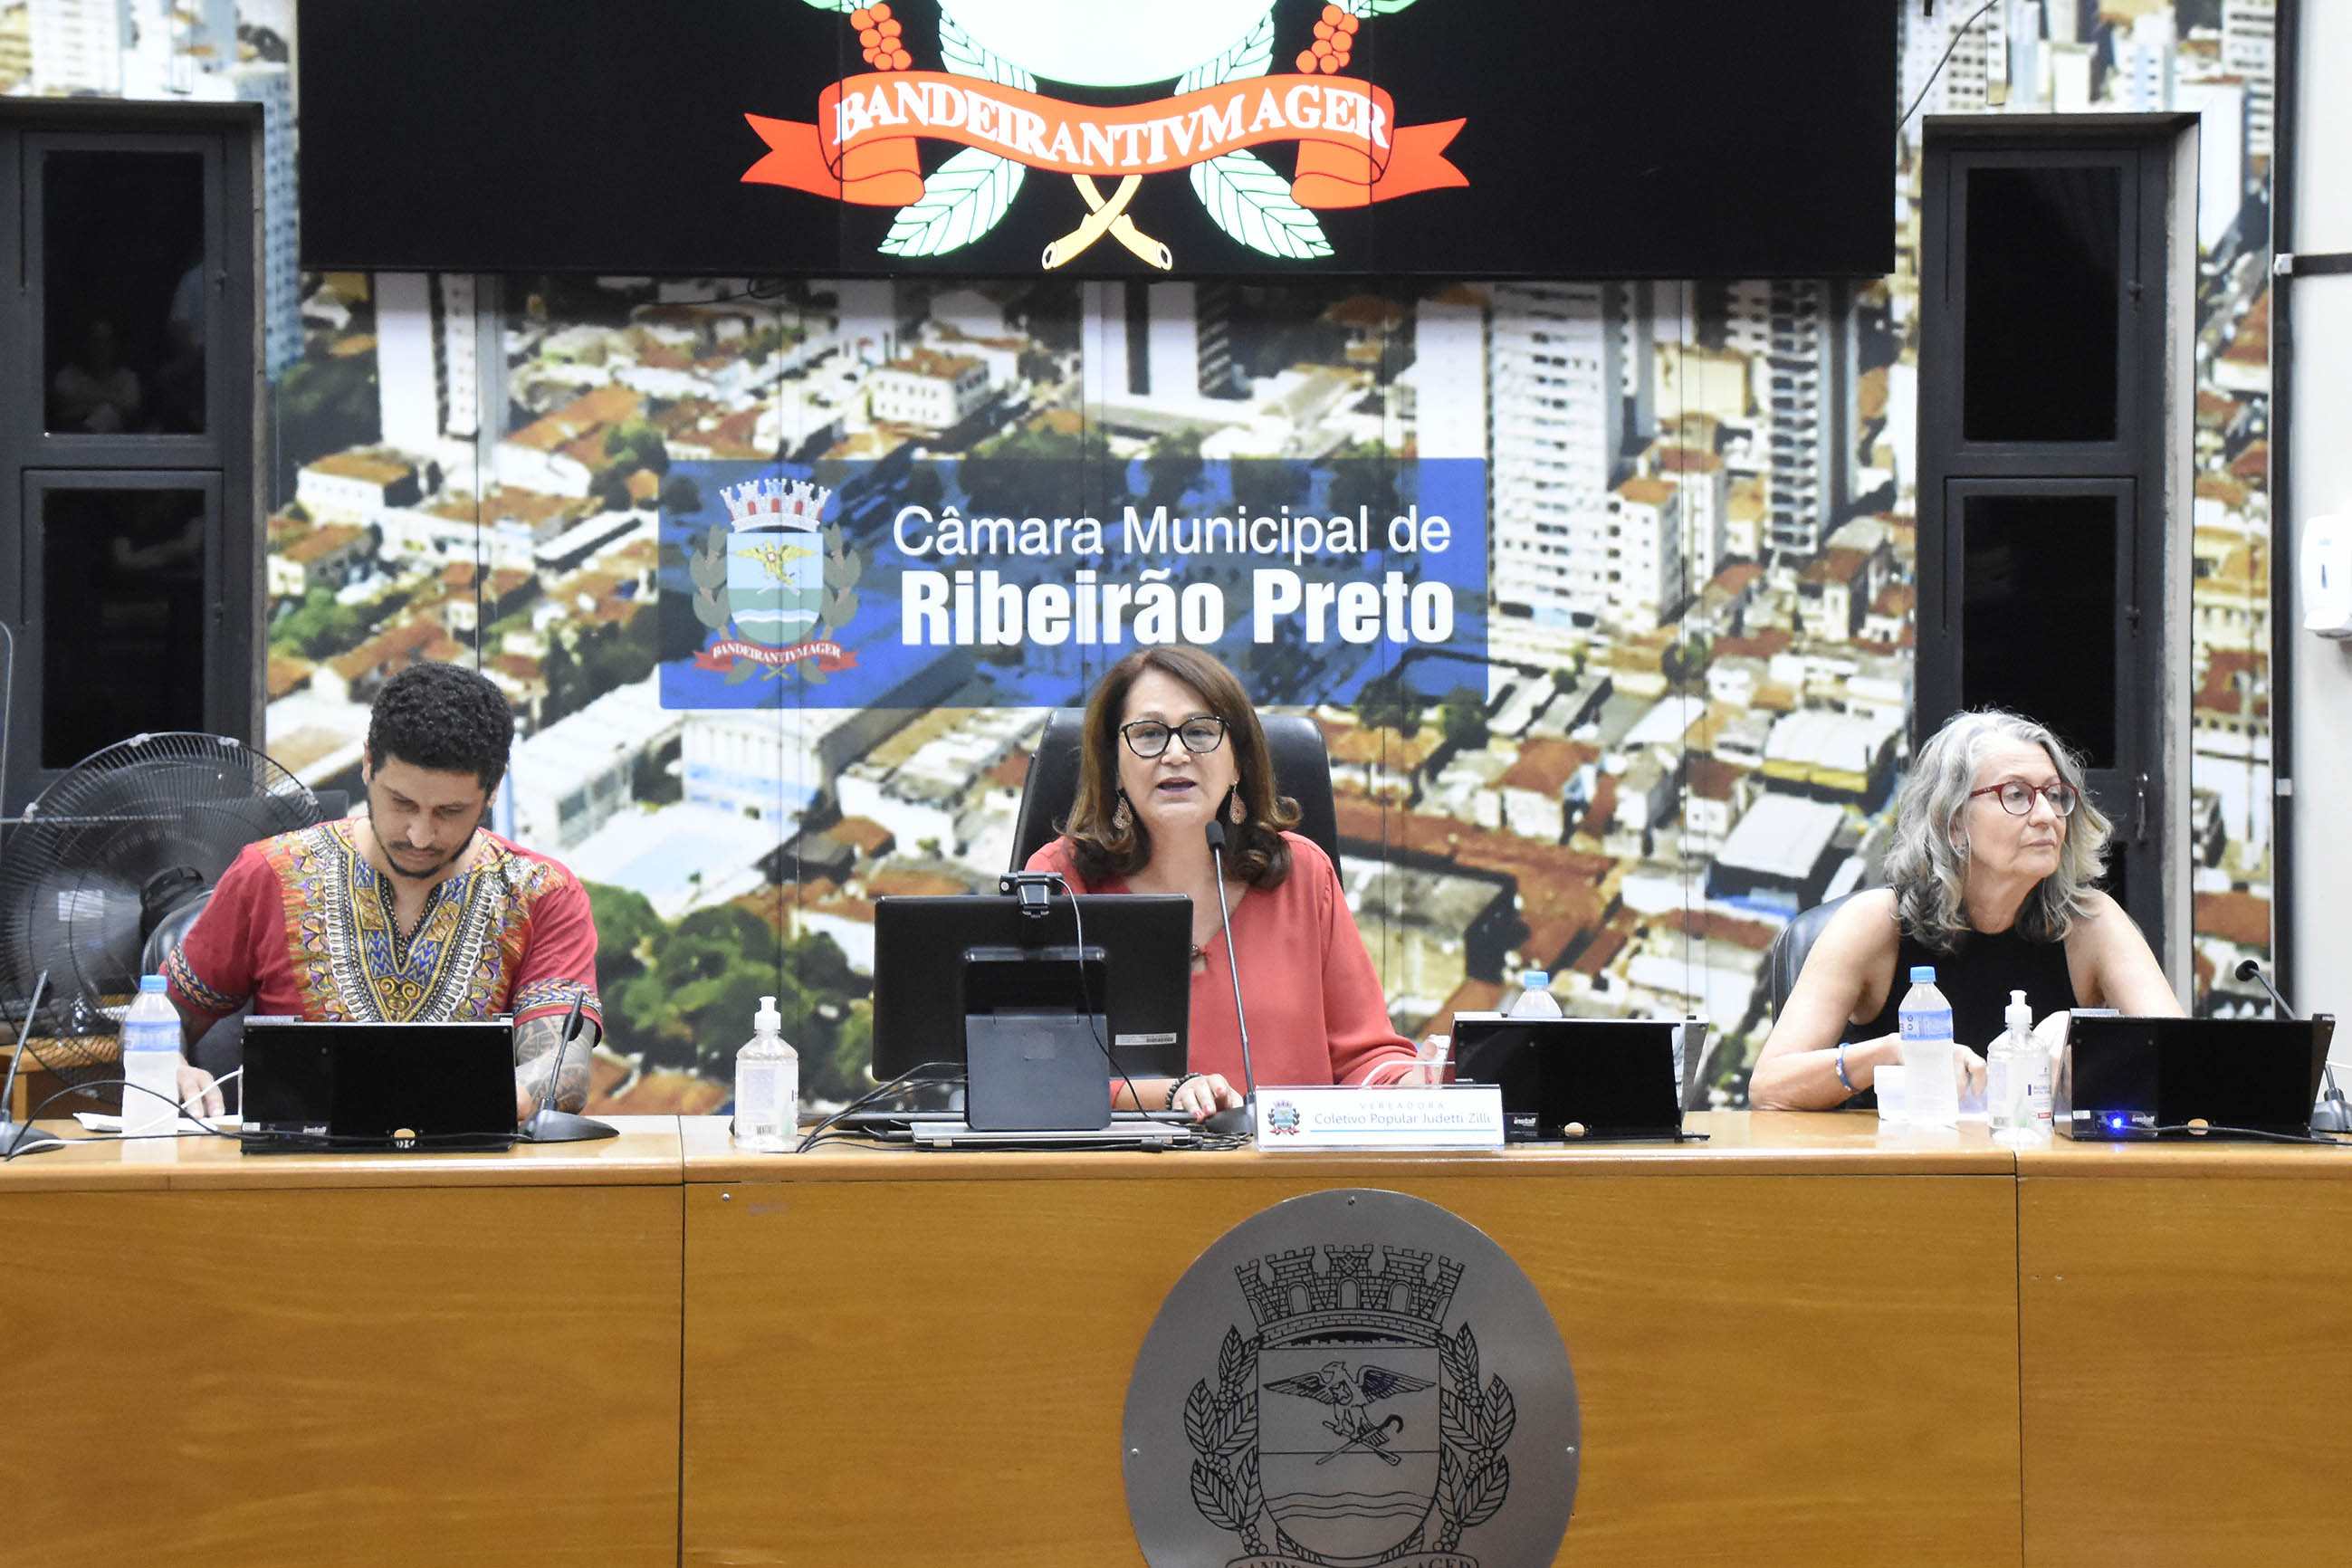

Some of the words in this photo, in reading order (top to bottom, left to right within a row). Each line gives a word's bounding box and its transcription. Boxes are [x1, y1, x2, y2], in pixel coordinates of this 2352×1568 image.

[833, 81, 1245, 167] BANDEIRANTIVM
[1249, 85, 1389, 148] AGER
[894, 506, 1104, 556] Câmara
[1123, 505, 1368, 566] Municipal
[1388, 505, 1451, 553] de
[902, 569, 1224, 645] Ribeirão
[1253, 561, 1455, 644] Preto
[1314, 1113, 1366, 1124] Coletivo
[1370, 1113, 1419, 1126] Popular
[1422, 1113, 1465, 1124] Judetti
[1468, 1113, 1492, 1124] Zilli
